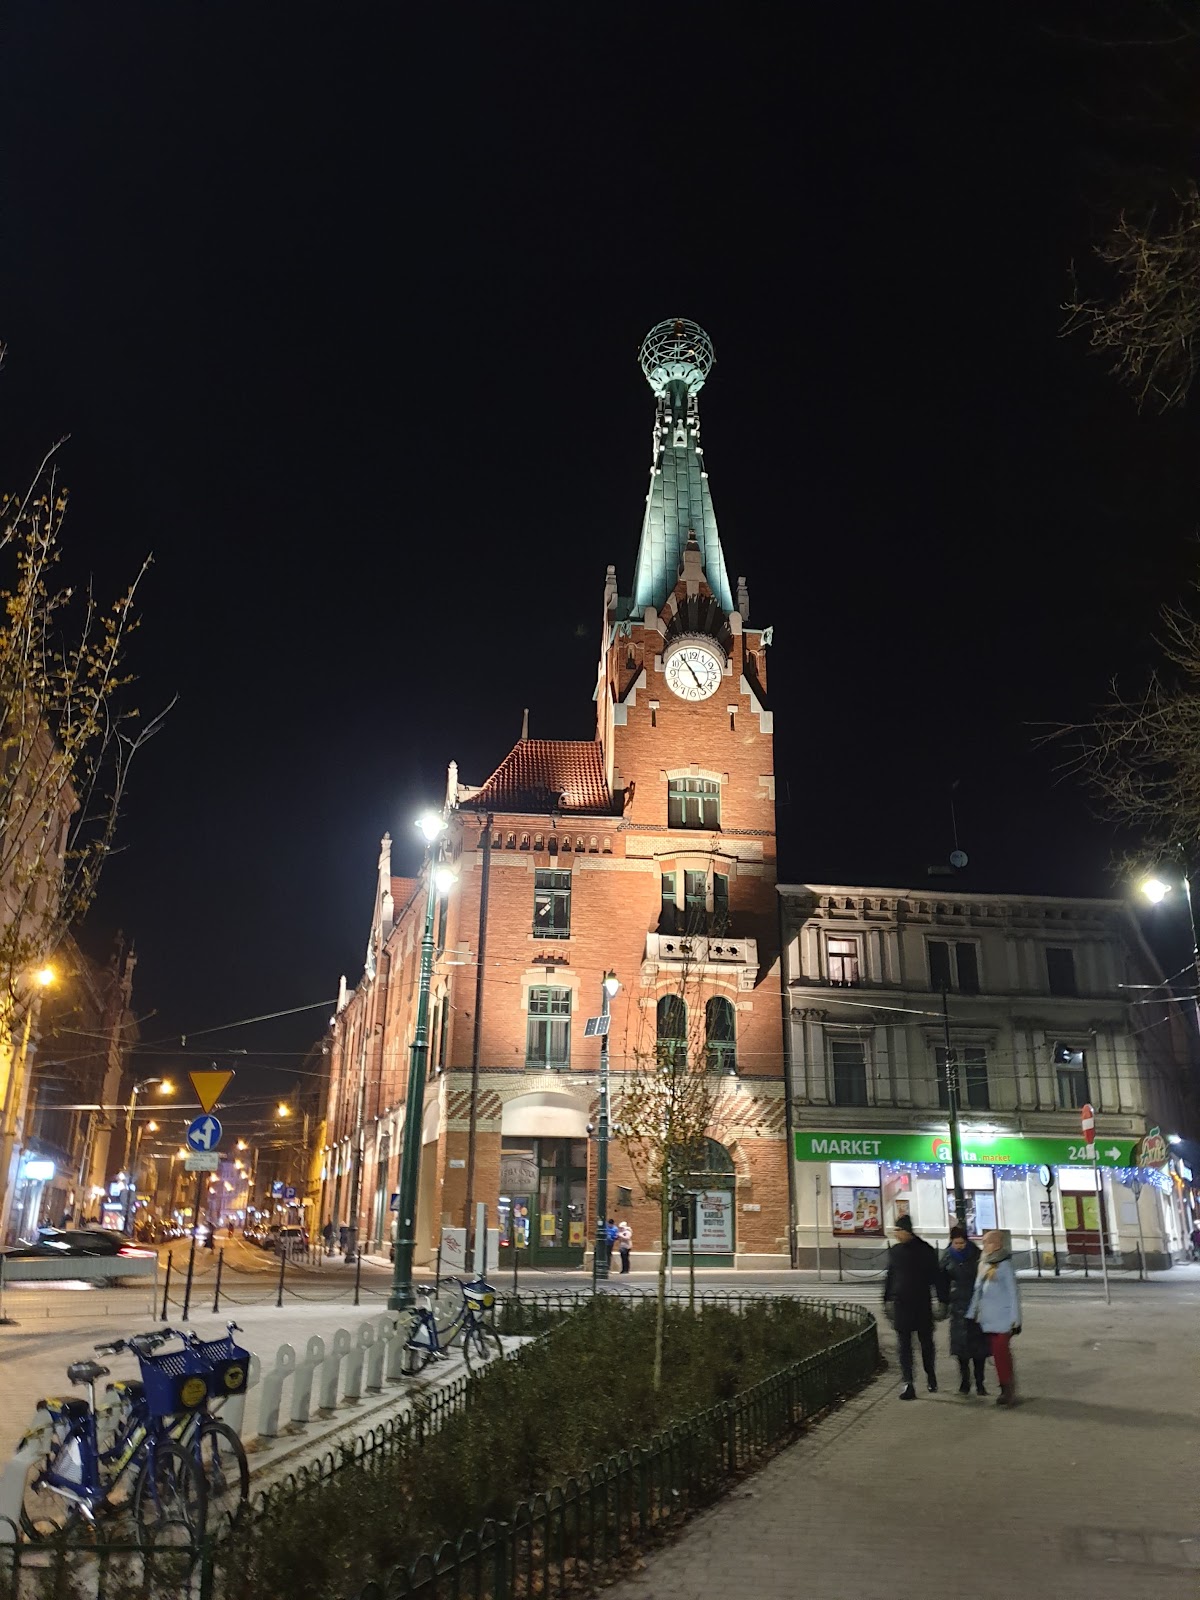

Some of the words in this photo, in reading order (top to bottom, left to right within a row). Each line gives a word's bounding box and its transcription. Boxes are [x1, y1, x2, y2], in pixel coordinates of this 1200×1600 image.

[689, 652, 698, 660] 12
[701, 655, 705, 663] 1
[672, 660, 680, 668] 10
[708, 662, 714, 670] 2
[711, 672, 717, 680] 3
[673, 680, 679, 688] 8
[707, 682, 713, 690] 4
[681, 687, 686, 695] 7
[690, 690, 697, 698] 6
[700, 688, 707, 696] 5
[811, 1138, 882, 1155] MARKET
